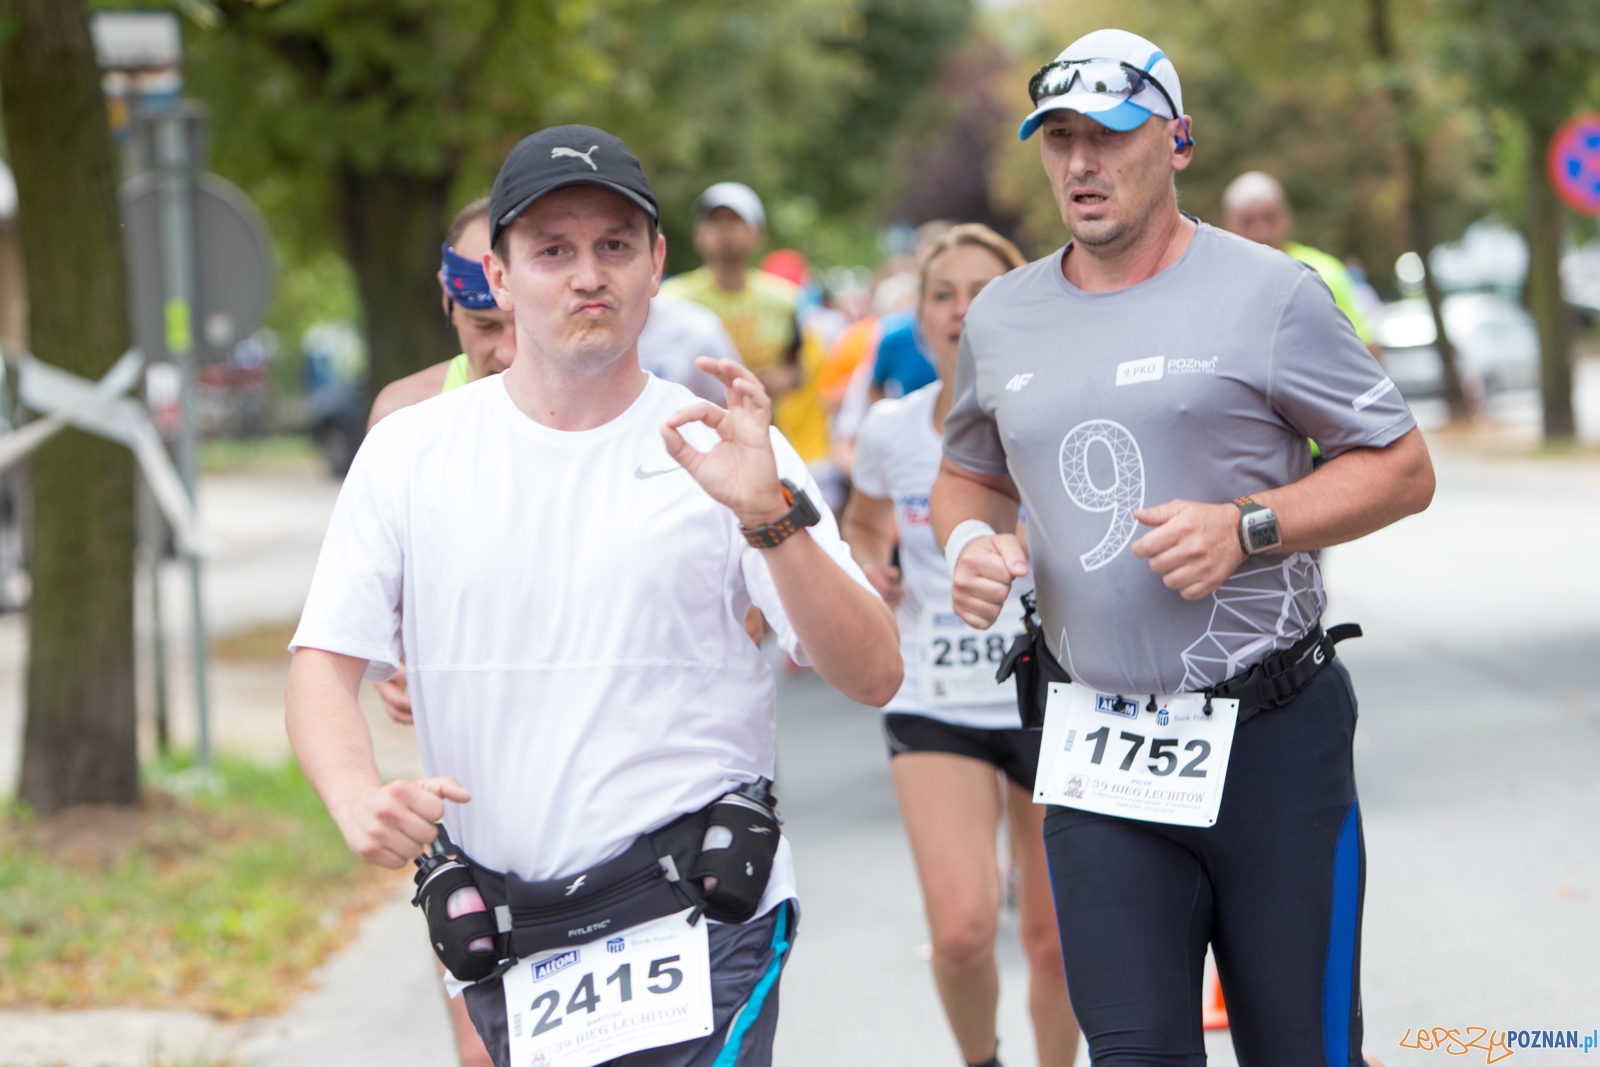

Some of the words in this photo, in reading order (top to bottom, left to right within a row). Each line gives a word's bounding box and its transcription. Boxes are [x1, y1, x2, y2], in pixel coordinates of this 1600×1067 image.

[1005, 373, 1034, 392] 4F
[1133, 363, 1156, 377] PKO
[1059, 419, 1145, 573] 9
[932, 633, 1025, 667] 258
[1085, 726, 1211, 778] 1752
[1092, 779, 1108, 791] 39
[1111, 783, 1142, 797] BIEG
[1144, 788, 1207, 803] LECHITÓW
[530, 954, 684, 1038] 2415
[554, 1037, 572, 1053] 39
[575, 1025, 608, 1045] BIEG
